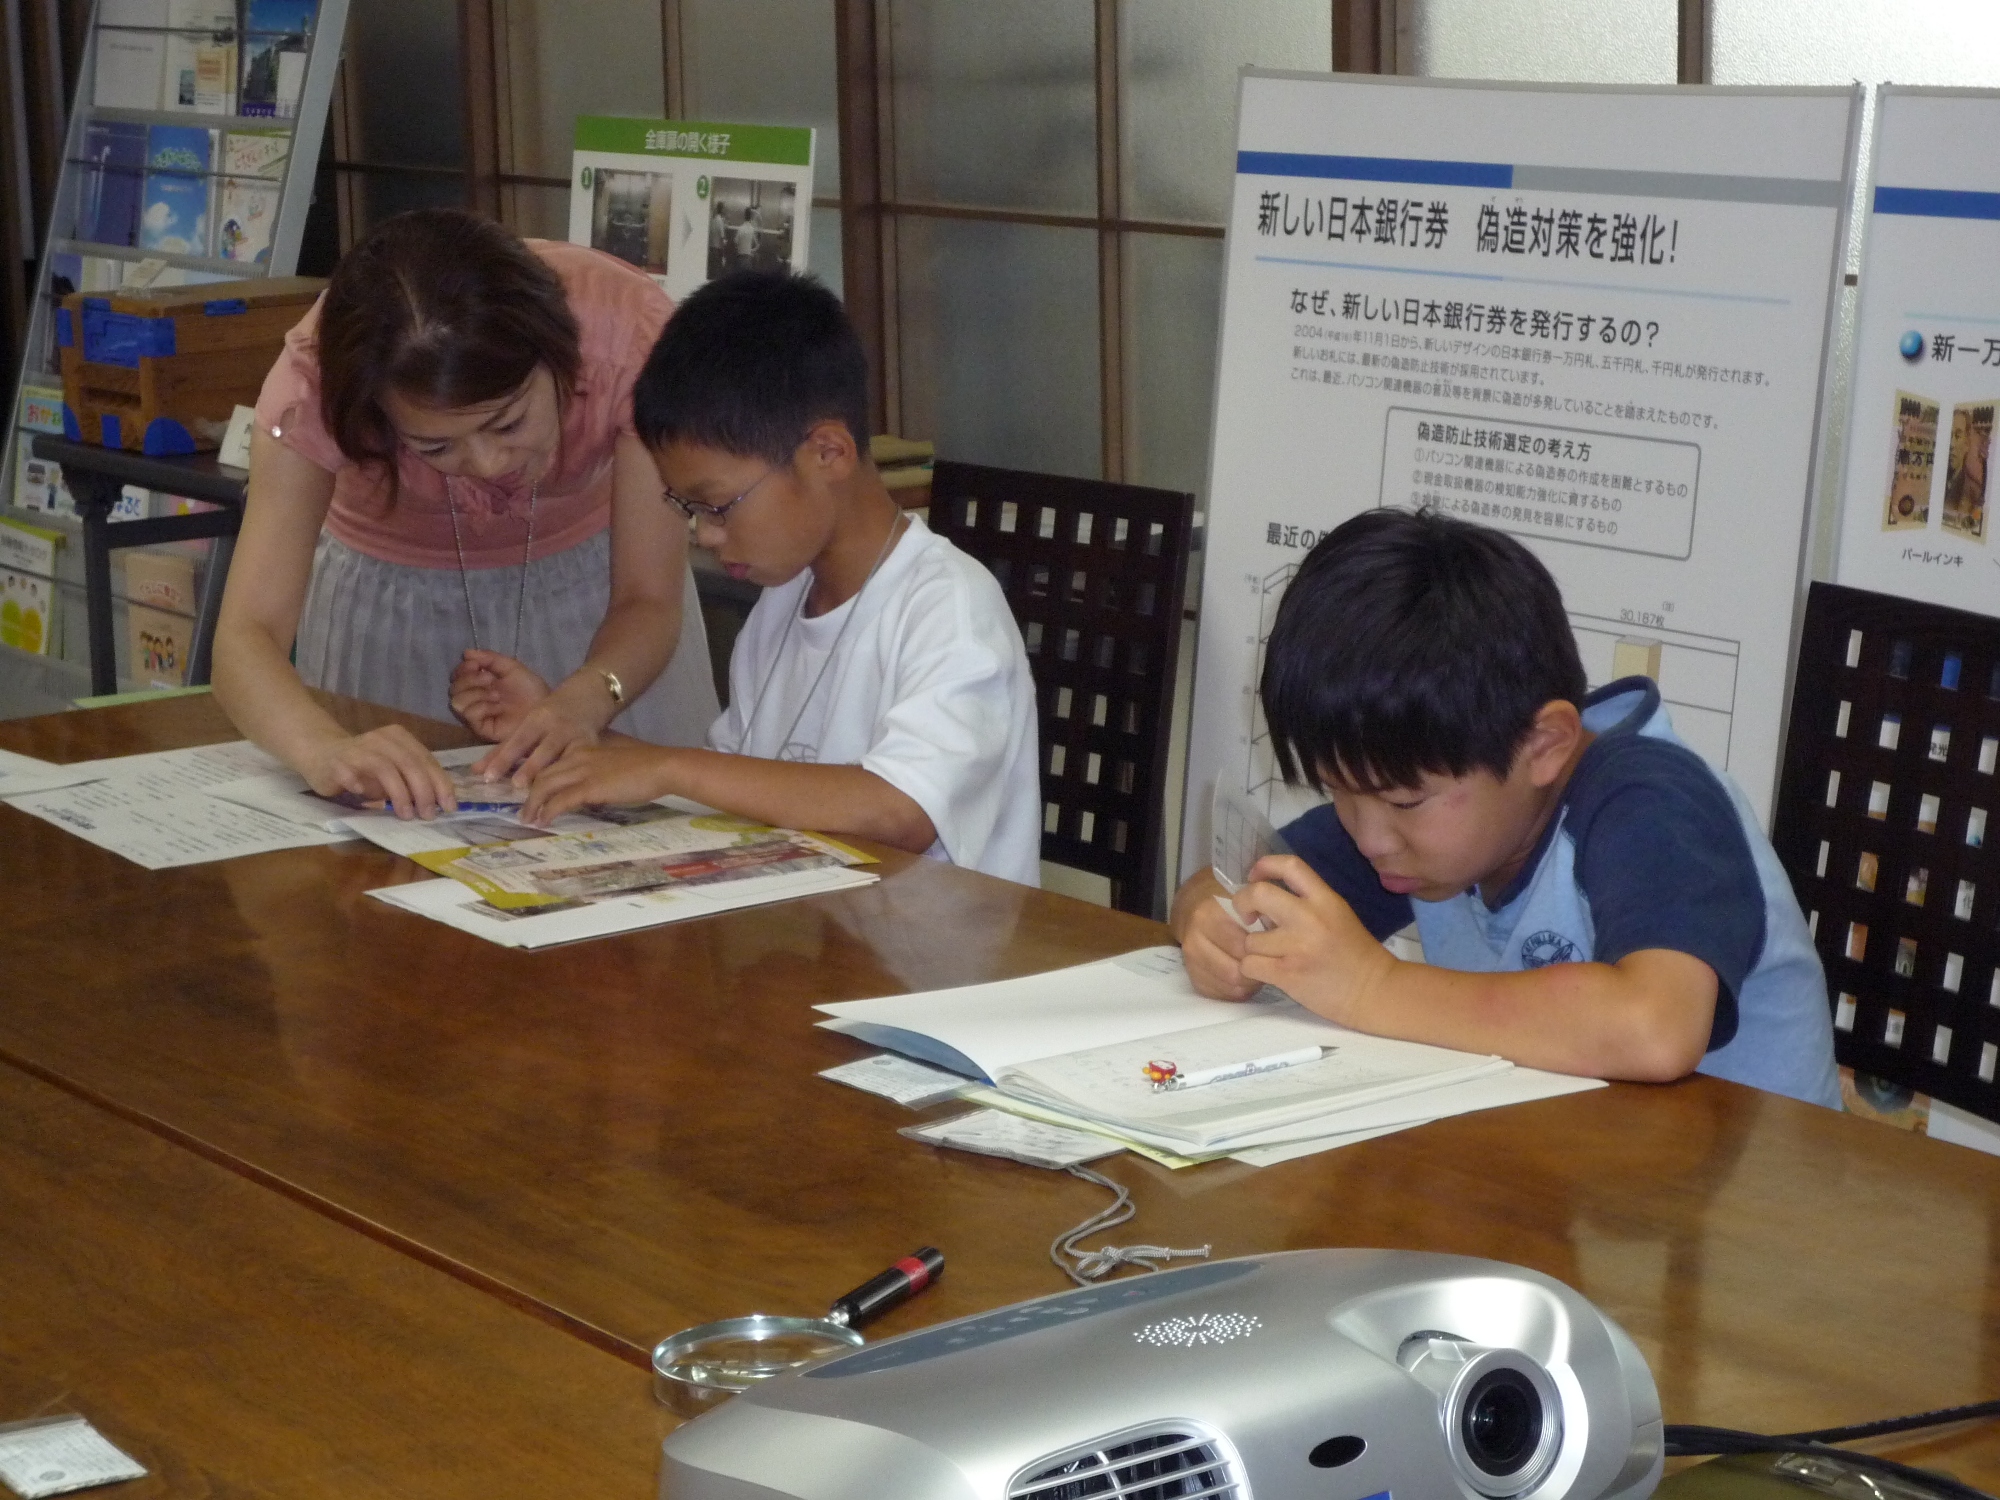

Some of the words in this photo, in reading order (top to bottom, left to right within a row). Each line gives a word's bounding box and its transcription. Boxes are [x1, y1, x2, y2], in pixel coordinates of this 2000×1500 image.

[1257, 190, 1449, 249] 新しい日本銀行券
[1476, 203, 1679, 265] 偽造対策を強化！
[1290, 289, 1660, 347] なぜ、新しい日本銀行券を発行するの？
[1417, 421, 1592, 462] 偽造防止技術選定の考え方
[1266, 521, 1328, 551] 最近の
